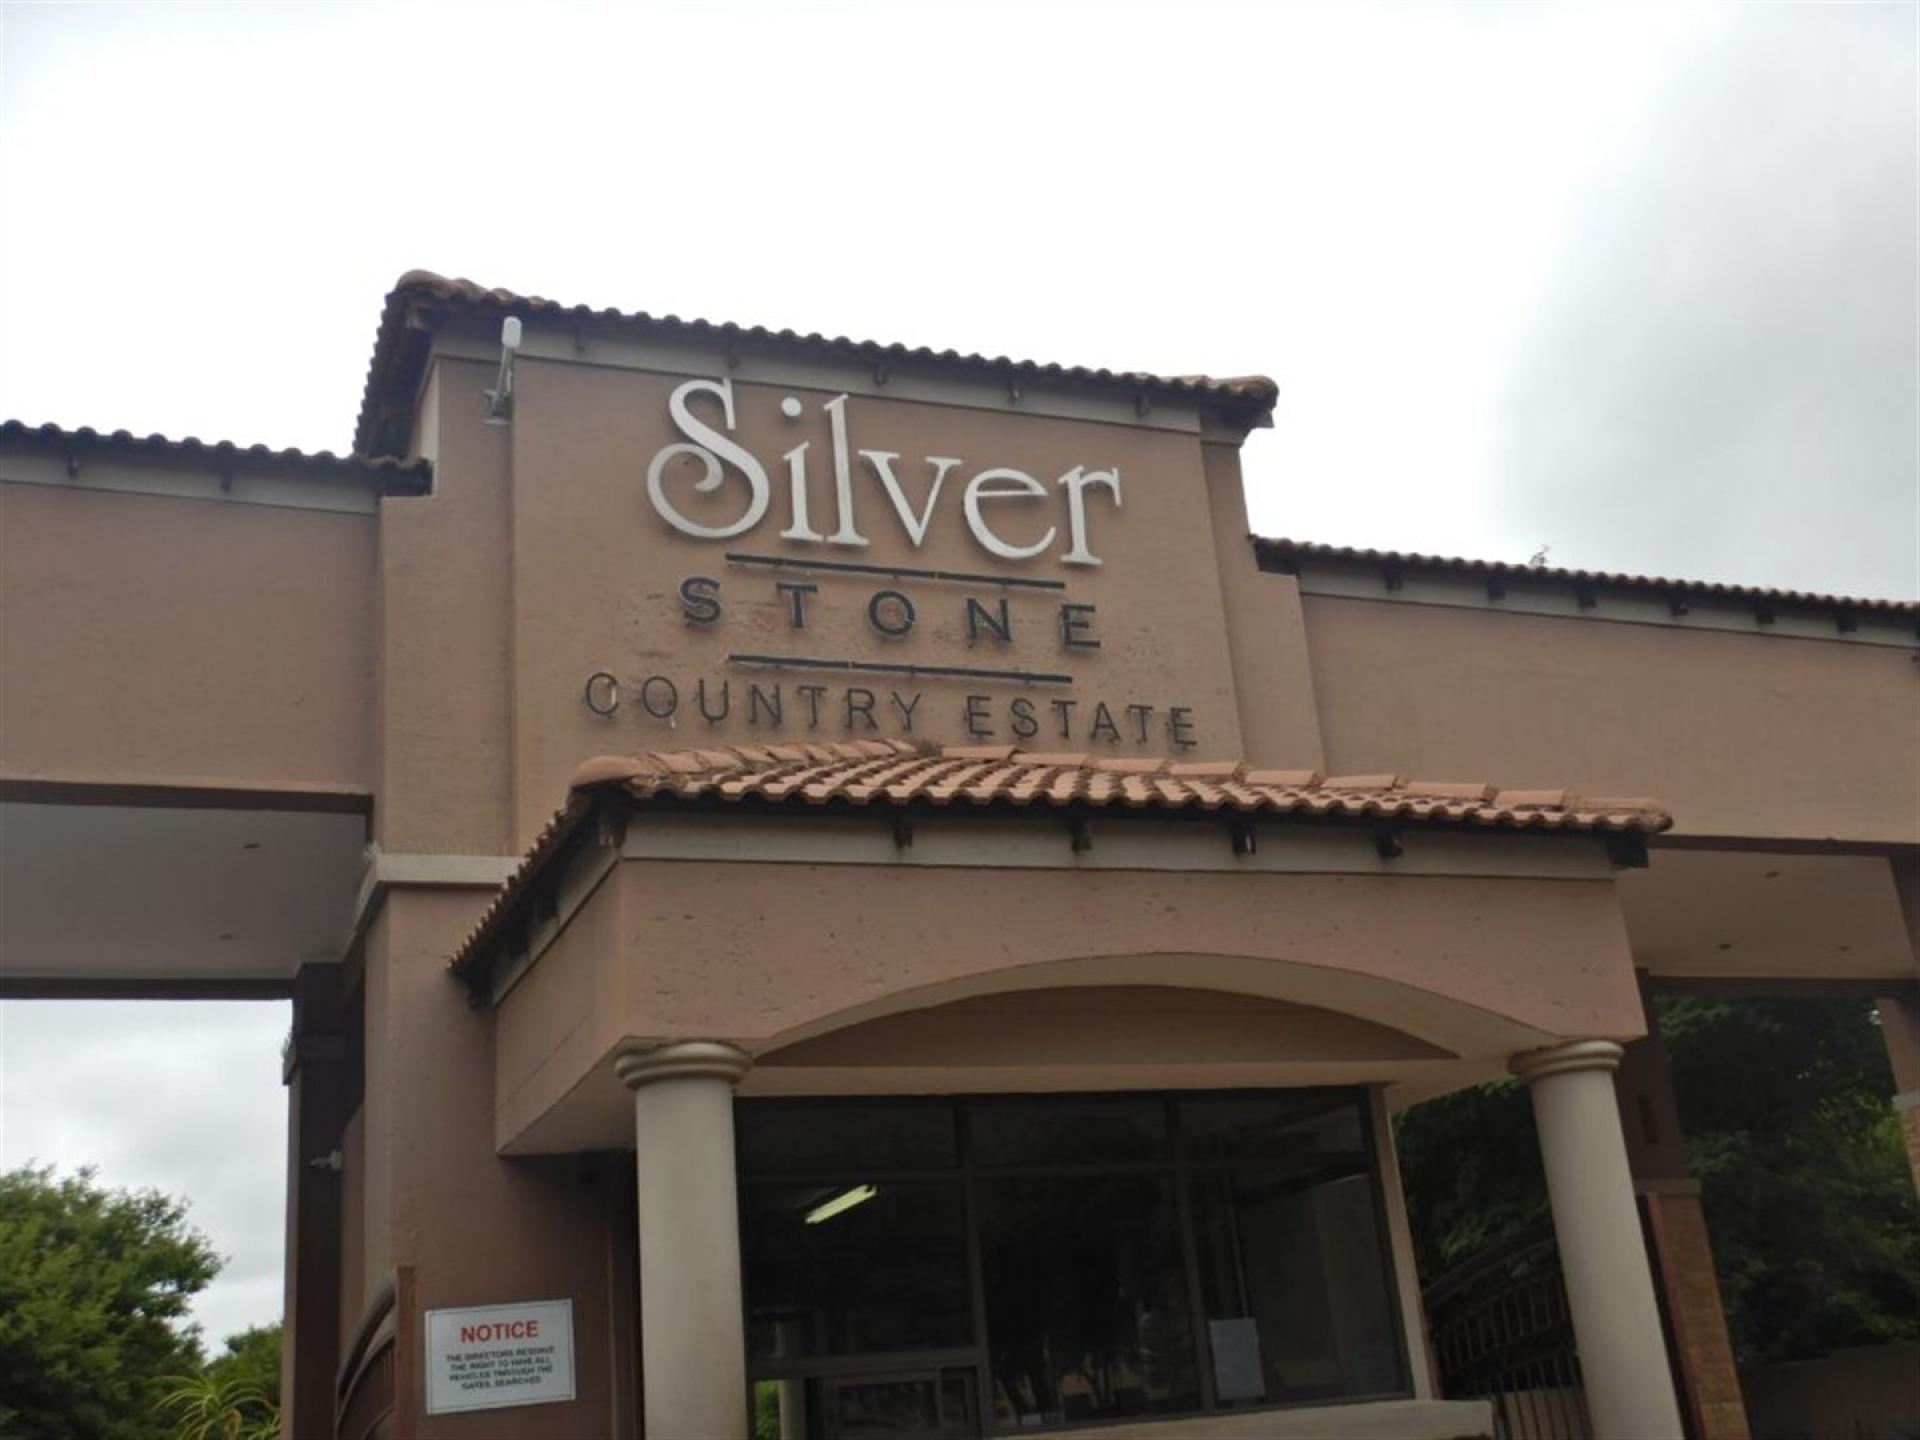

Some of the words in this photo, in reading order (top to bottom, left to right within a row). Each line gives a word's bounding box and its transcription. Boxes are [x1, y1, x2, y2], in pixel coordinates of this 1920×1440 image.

[646, 377, 1121, 566] Silver
[680, 576, 1101, 648] STONE
[585, 673, 921, 731] COUNTRY
[966, 695, 1197, 746] ESTATE
[461, 1320, 538, 1343] NOTICE
[447, 1353, 462, 1362] THE
[465, 1350, 513, 1361] DIRECTORS
[451, 1363, 466, 1371] THE
[470, 1360, 495, 1369] RIGHT
[498, 1359, 509, 1367] TO
[535, 1356, 550, 1364] ALL
[450, 1371, 491, 1381] VEHICLES
[494, 1367, 535, 1377] THROUGH
